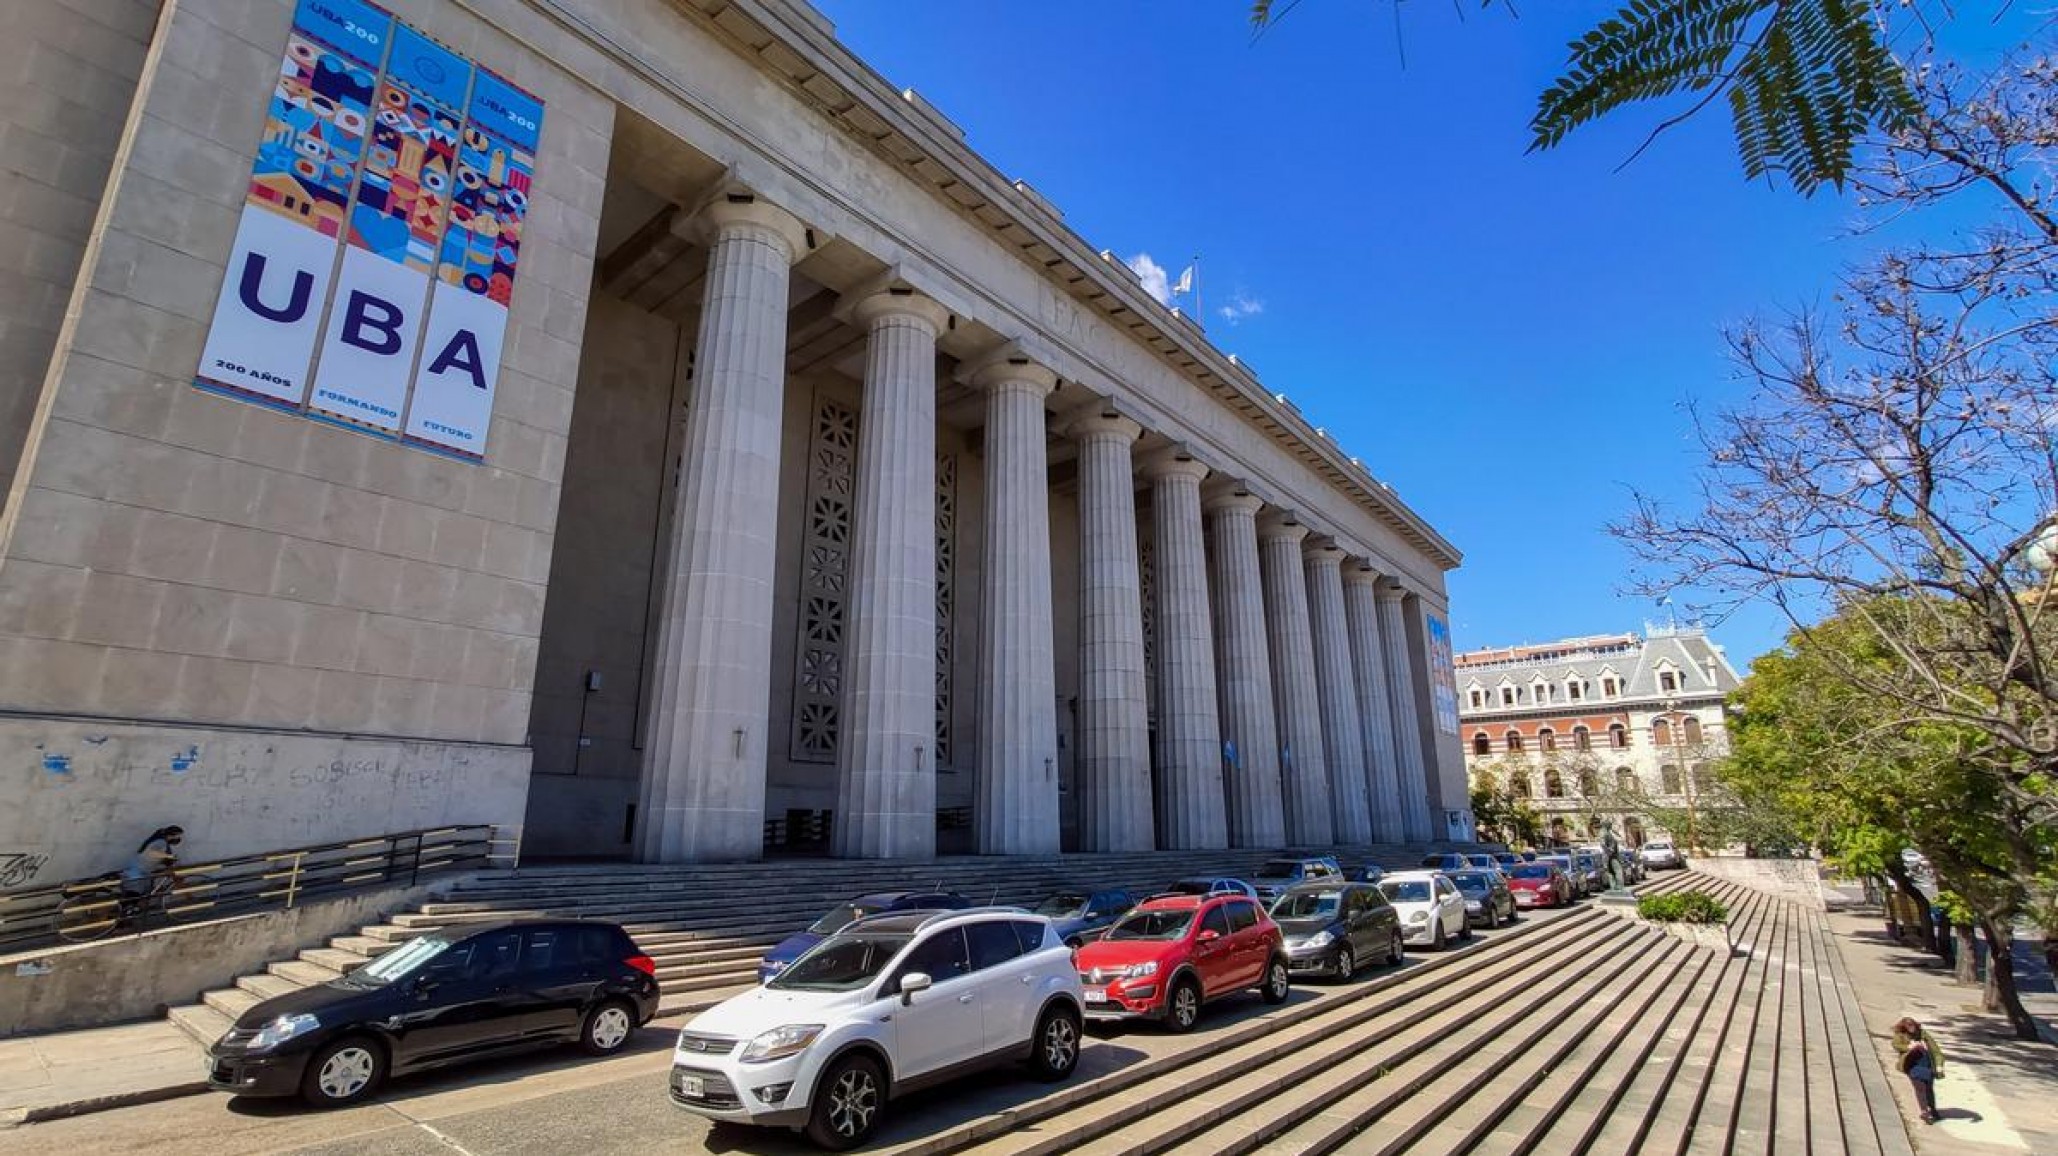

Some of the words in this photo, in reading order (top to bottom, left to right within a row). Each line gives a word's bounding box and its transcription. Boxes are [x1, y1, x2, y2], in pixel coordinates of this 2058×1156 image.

[216, 359, 246, 374] 200
[249, 369, 292, 388] AÑOS
[318, 388, 397, 418] FORMANDO
[423, 419, 474, 440] FUTURO
